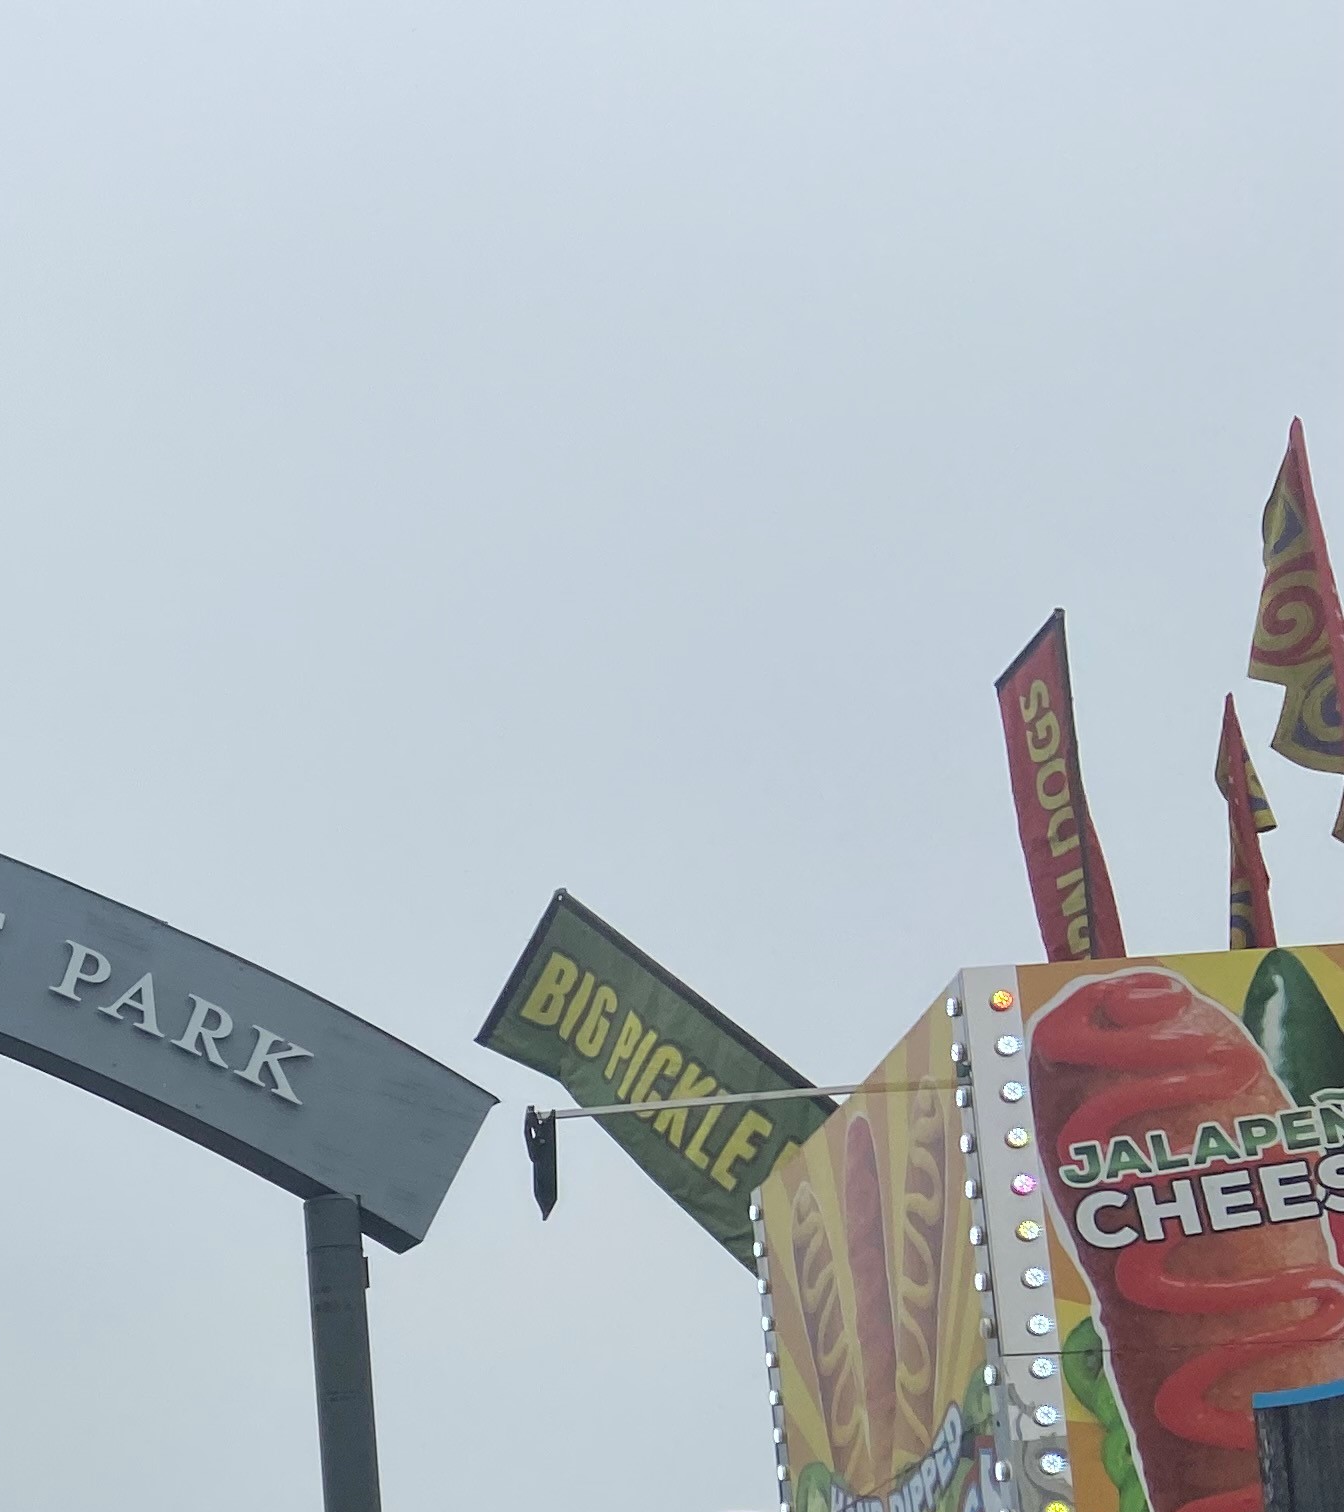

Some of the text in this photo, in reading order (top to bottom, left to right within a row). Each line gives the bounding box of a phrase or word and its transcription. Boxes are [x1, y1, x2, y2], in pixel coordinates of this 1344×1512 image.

[49, 937, 314, 1108] PARK
[519, 951, 774, 1191] BIG PICKLE
